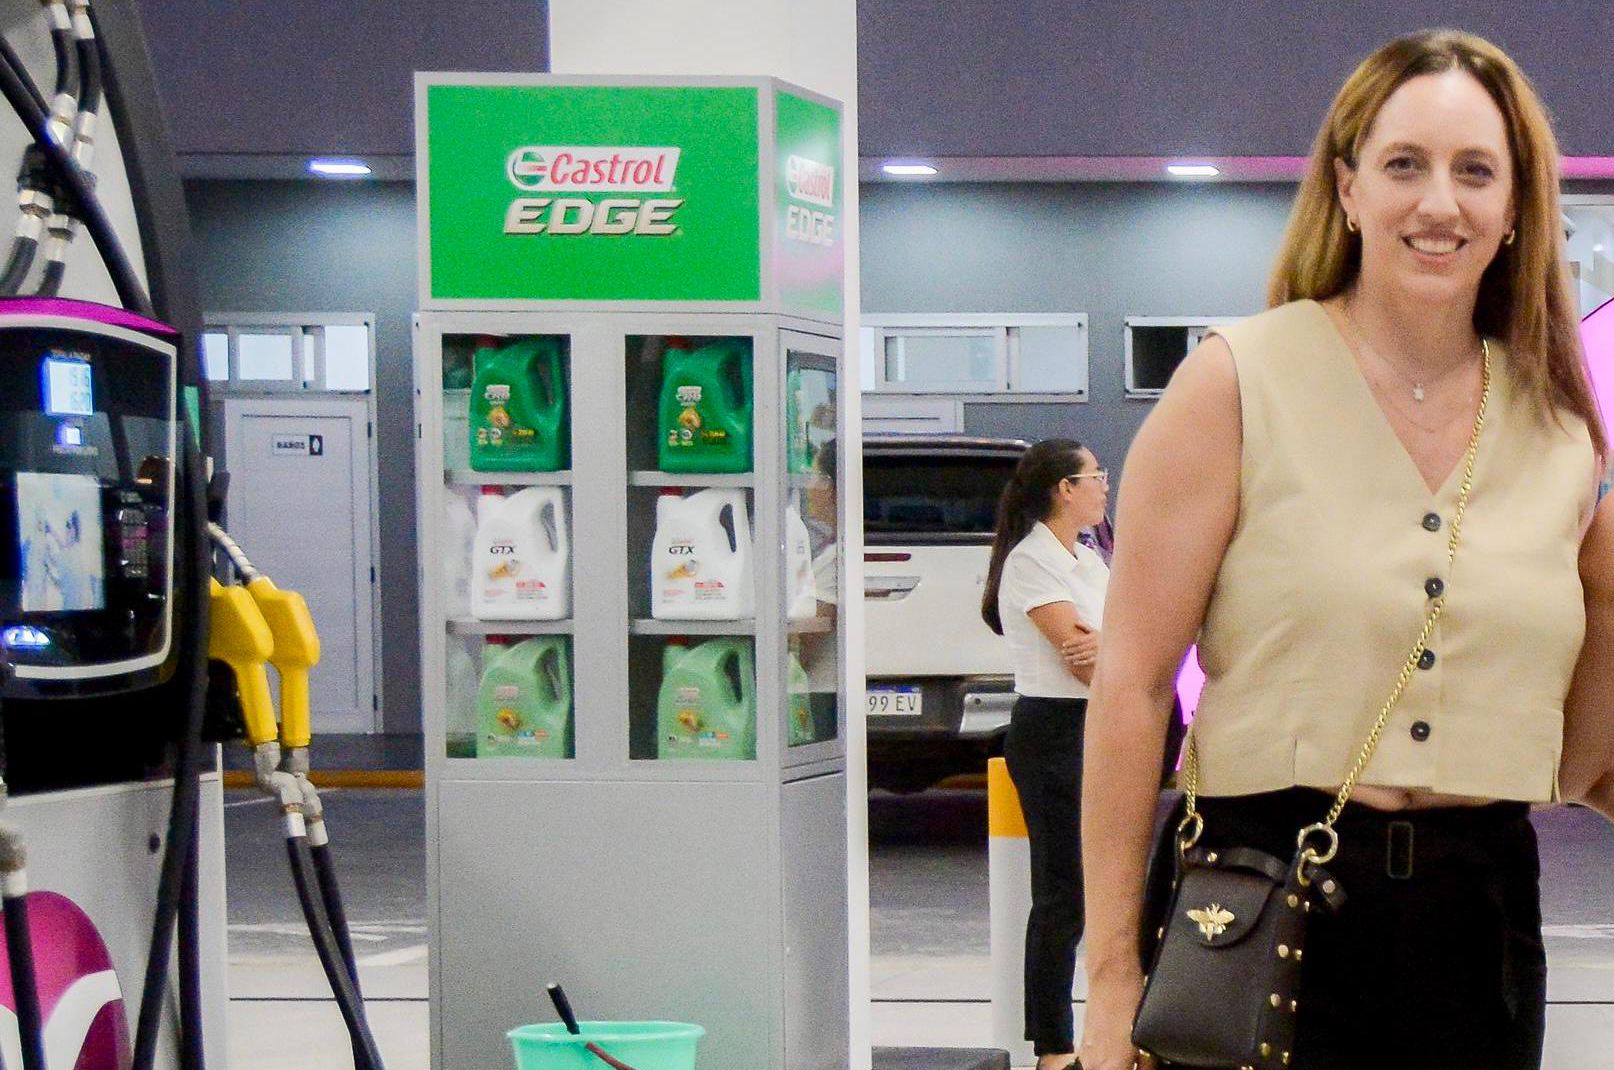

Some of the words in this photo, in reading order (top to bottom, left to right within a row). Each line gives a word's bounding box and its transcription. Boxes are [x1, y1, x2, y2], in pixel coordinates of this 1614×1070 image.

[550, 153, 666, 185] Castrol
[504, 198, 685, 236] EDGE
[787, 203, 833, 247] EDGE
[489, 545, 516, 555] GTX
[668, 545, 695, 555] GTX
[869, 695, 889, 712] 99
[896, 695, 916, 712] EV
